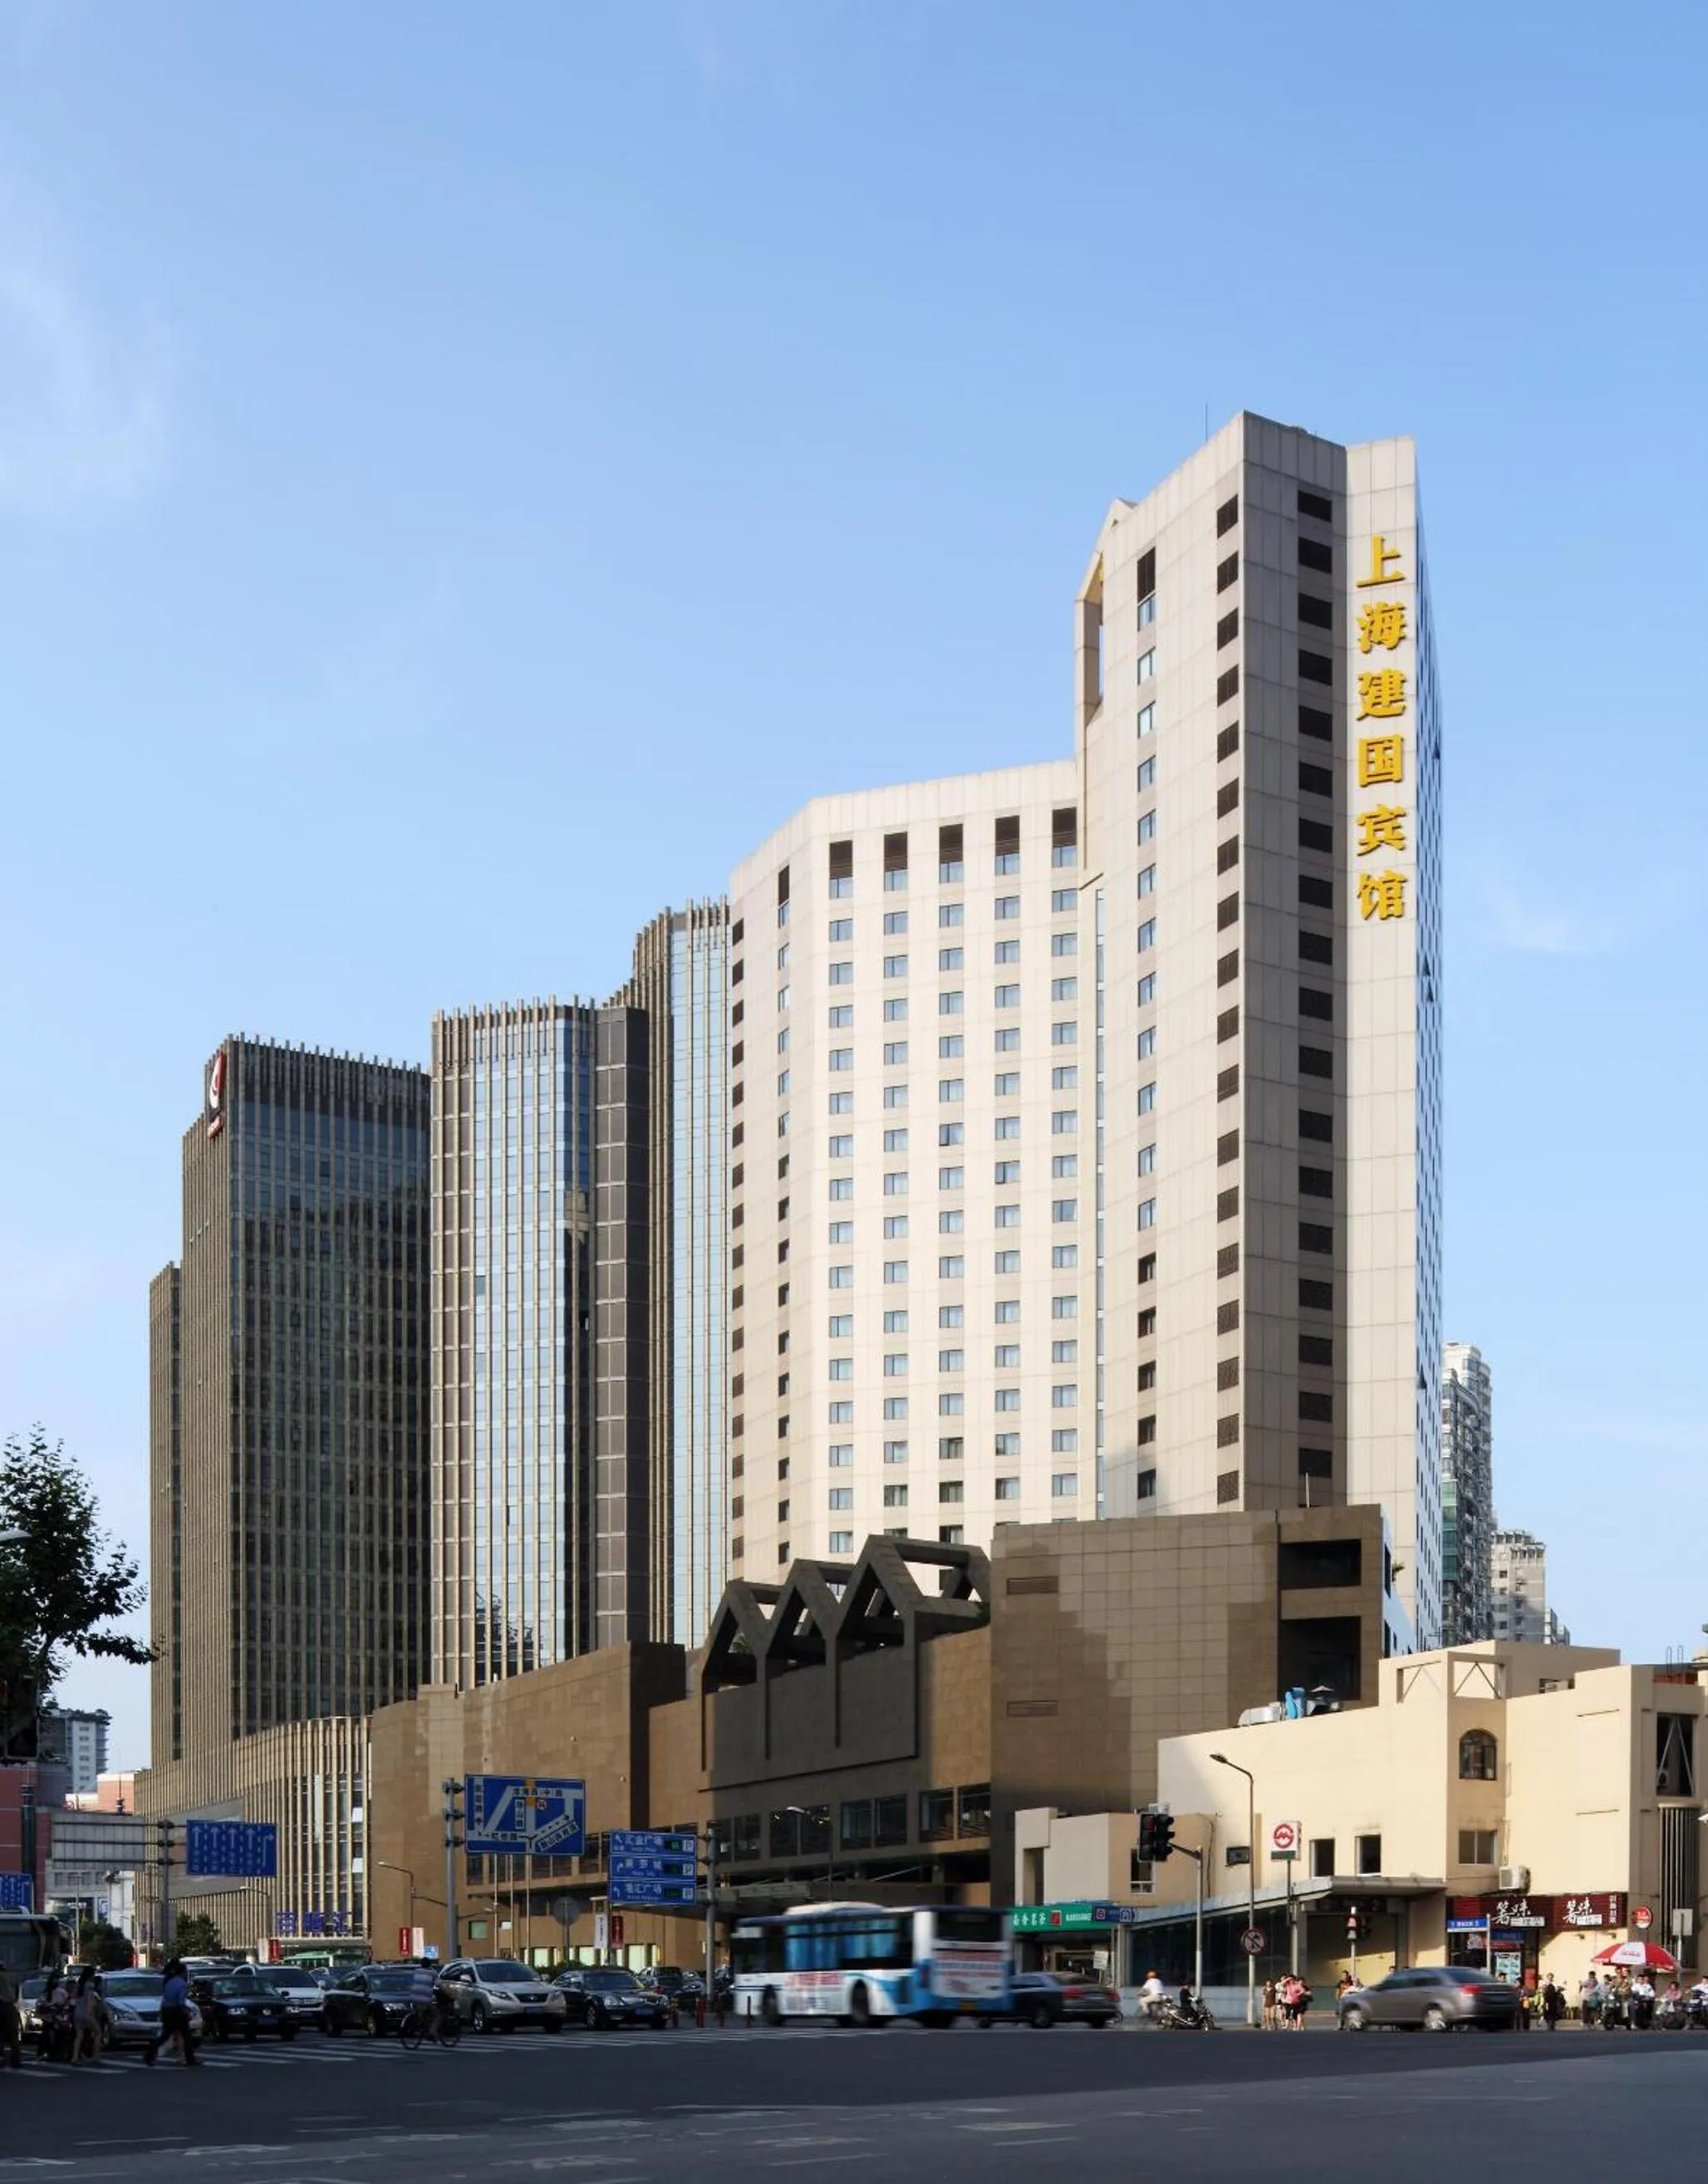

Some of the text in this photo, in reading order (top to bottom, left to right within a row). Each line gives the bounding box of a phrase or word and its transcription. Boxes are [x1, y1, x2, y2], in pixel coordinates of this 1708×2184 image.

[1357, 534, 1406, 920] 上海建国宾馆
